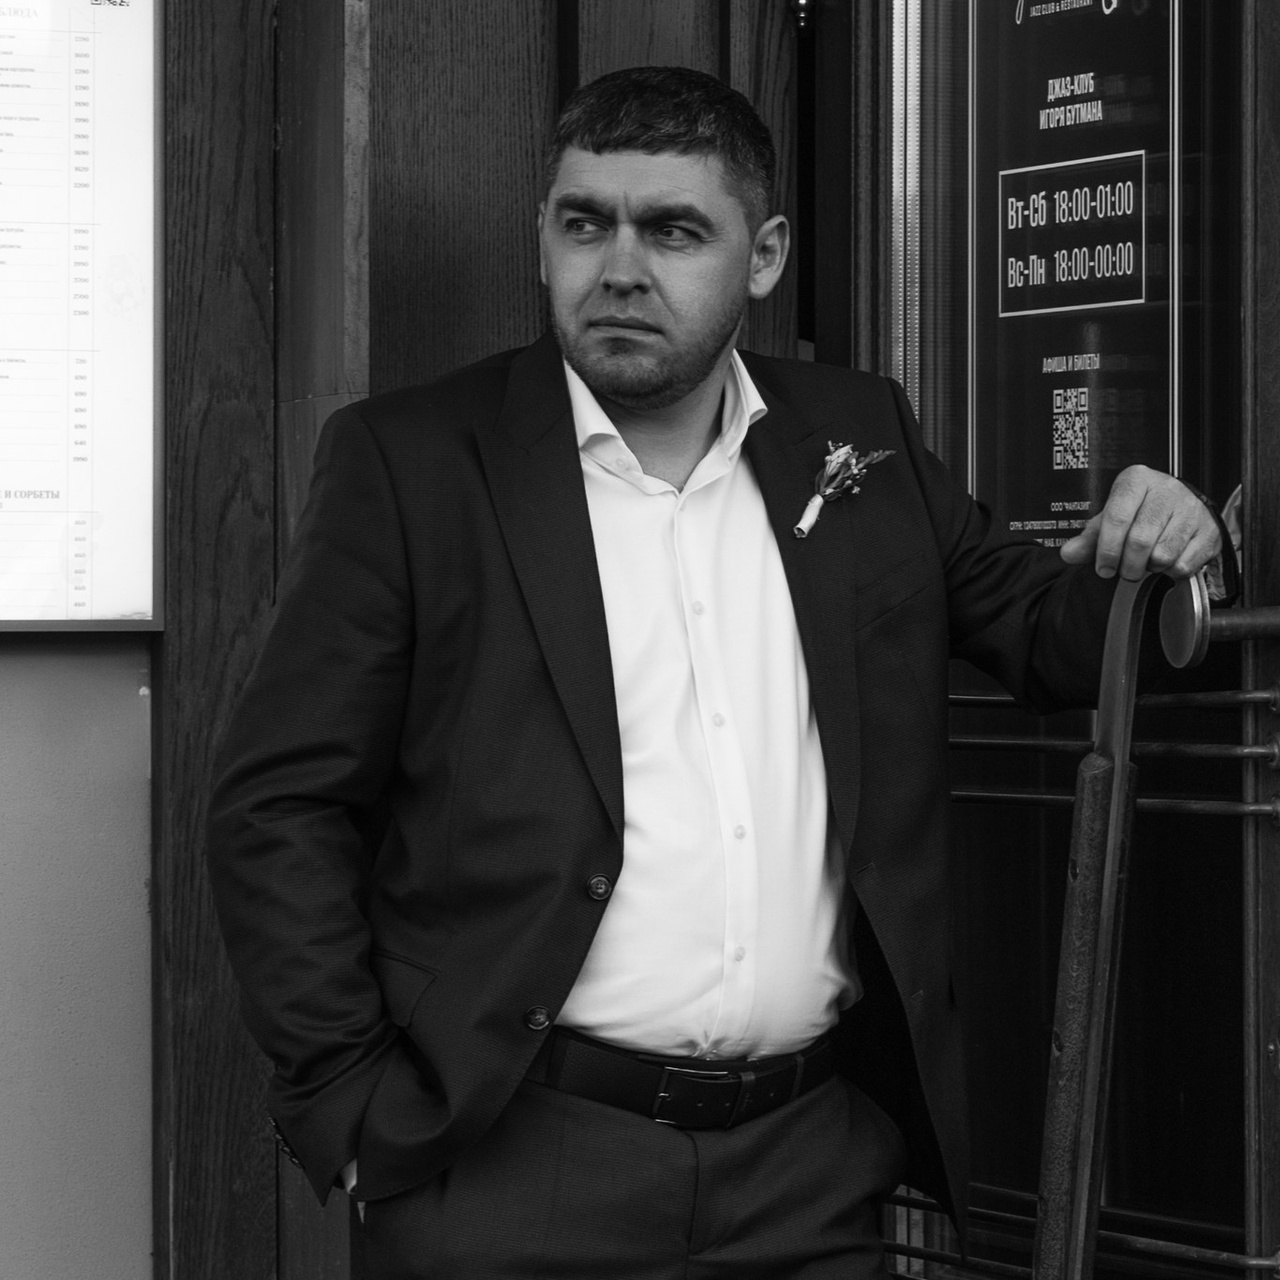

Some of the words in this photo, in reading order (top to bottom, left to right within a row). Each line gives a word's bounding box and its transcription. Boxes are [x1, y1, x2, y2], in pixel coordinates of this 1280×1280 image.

[1029, 4, 1041, 18] JAZZ
[1042, 2, 1055, 15] CLUB
[1047, 72, 1094, 102] ДЖАЗ-КЛУБ
[1039, 105, 1065, 130] ИГОРЯ
[1066, 99, 1103, 127] БУТМАНА
[1007, 190, 1047, 230] Вт-Сб
[1053, 180, 1134, 224] 18:00-01:00
[1007, 254, 1046, 288] Вс-Пн
[1053, 241, 1134, 283] 18:00-00:00
[1042, 356, 1066, 374] АФИША
[1074, 353, 1100, 372] БИЛЕТЫ
[5, 490, 12, 499] И
[14, 489, 60, 499] СОРБЕТЫ
